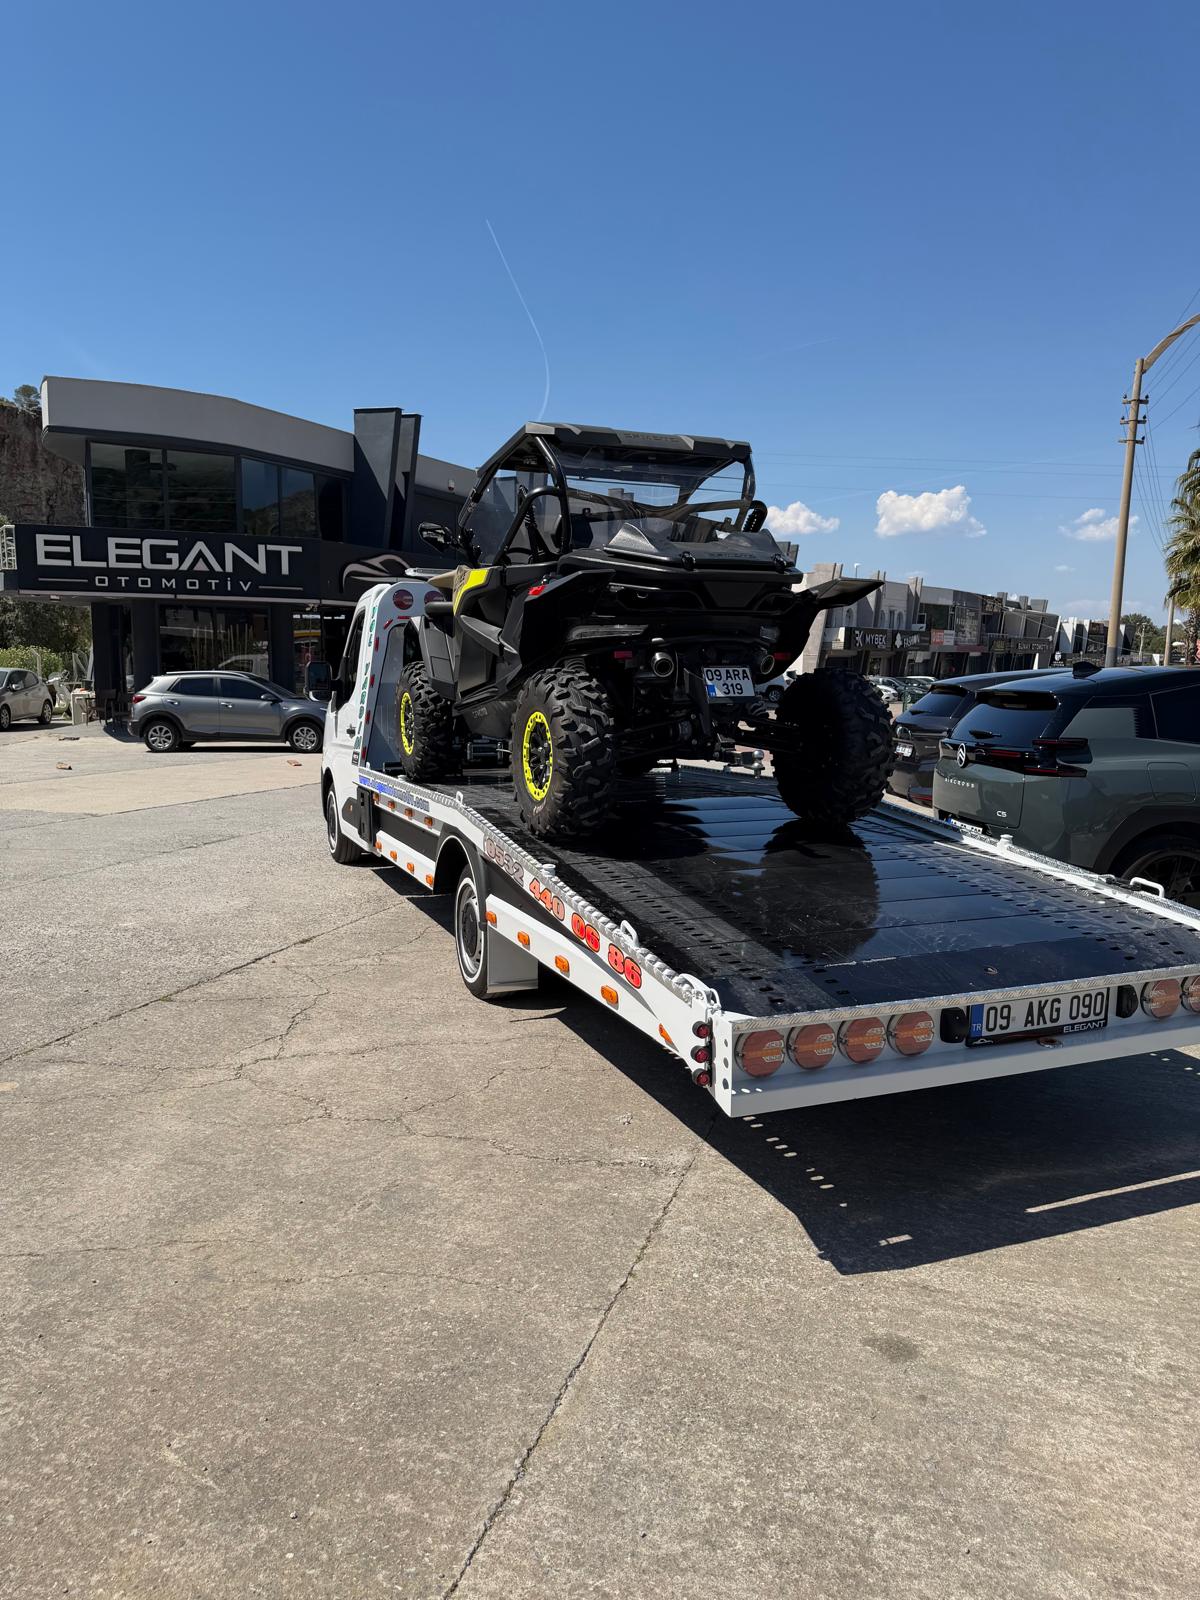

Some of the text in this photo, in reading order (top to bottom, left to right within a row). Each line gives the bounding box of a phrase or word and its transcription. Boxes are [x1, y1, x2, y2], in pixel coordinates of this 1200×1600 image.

[35, 533, 303, 576] ELEGANT
[705, 669, 750, 681] 09 ARA
[722, 682, 744, 695] 319
[996, 810, 1007, 818] C5
[484, 837, 643, 990] 0532 440 06 86
[985, 991, 1105, 1032] 09 AKG 090
[972, 1023, 982, 1032] TR
[1063, 1019, 1107, 1034] ELEGANT
